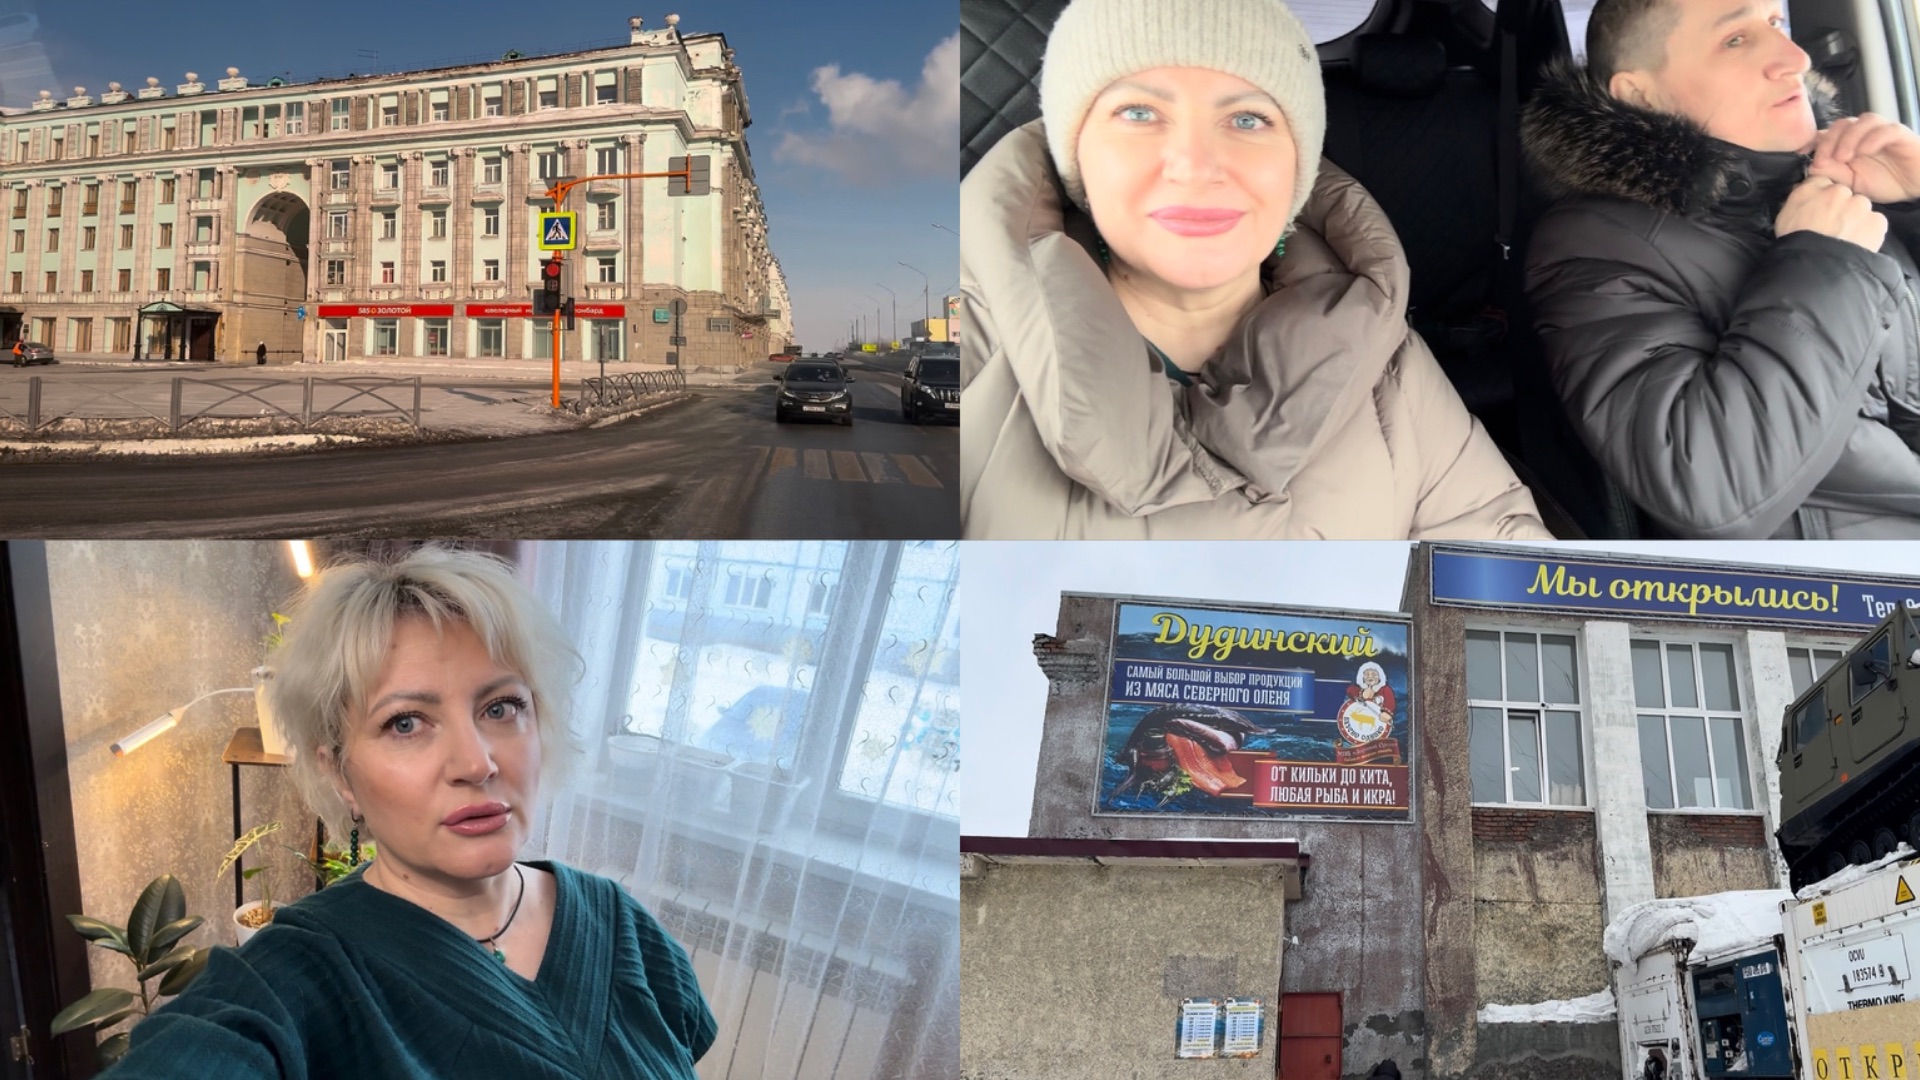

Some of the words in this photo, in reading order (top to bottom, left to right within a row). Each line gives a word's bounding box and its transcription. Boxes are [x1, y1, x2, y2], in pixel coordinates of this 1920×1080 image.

[377, 306, 411, 314] ЗОЛОТОЙ
[1526, 563, 1602, 598] Мы
[1609, 578, 1839, 616] открылись!
[1151, 611, 1378, 662] Дудинский
[1126, 665, 1163, 679] САМЫЙ
[1165, 667, 1211, 683] БОЛЬШОЙ
[1214, 671, 1246, 685] ВЫБОР
[1248, 673, 1303, 688] ПРОДУКЦИИ
[1125, 681, 1141, 697] ИЗ
[1145, 682, 1179, 699] МЯСА
[1183, 684, 1250, 704] СЕВЕРНОГО
[1253, 689, 1290, 706] ОЛЕНЯ
[1271, 765, 1288, 782] ОТ
[1290, 766, 1337, 784] КИЛЬКИ
[1340, 768, 1357, 786] ДО
[1359, 768, 1393, 787] КИТА,
[1270, 786, 1312, 803] ЛЮБАЯ
[1315, 787, 1349, 804] РЫБА
[1352, 788, 1360, 804] И
[1363, 788, 1396, 805] ИКРА!
[1847, 996, 1883, 1010] THERMO
[1816, 1053, 1920, 1080] ОТКР
